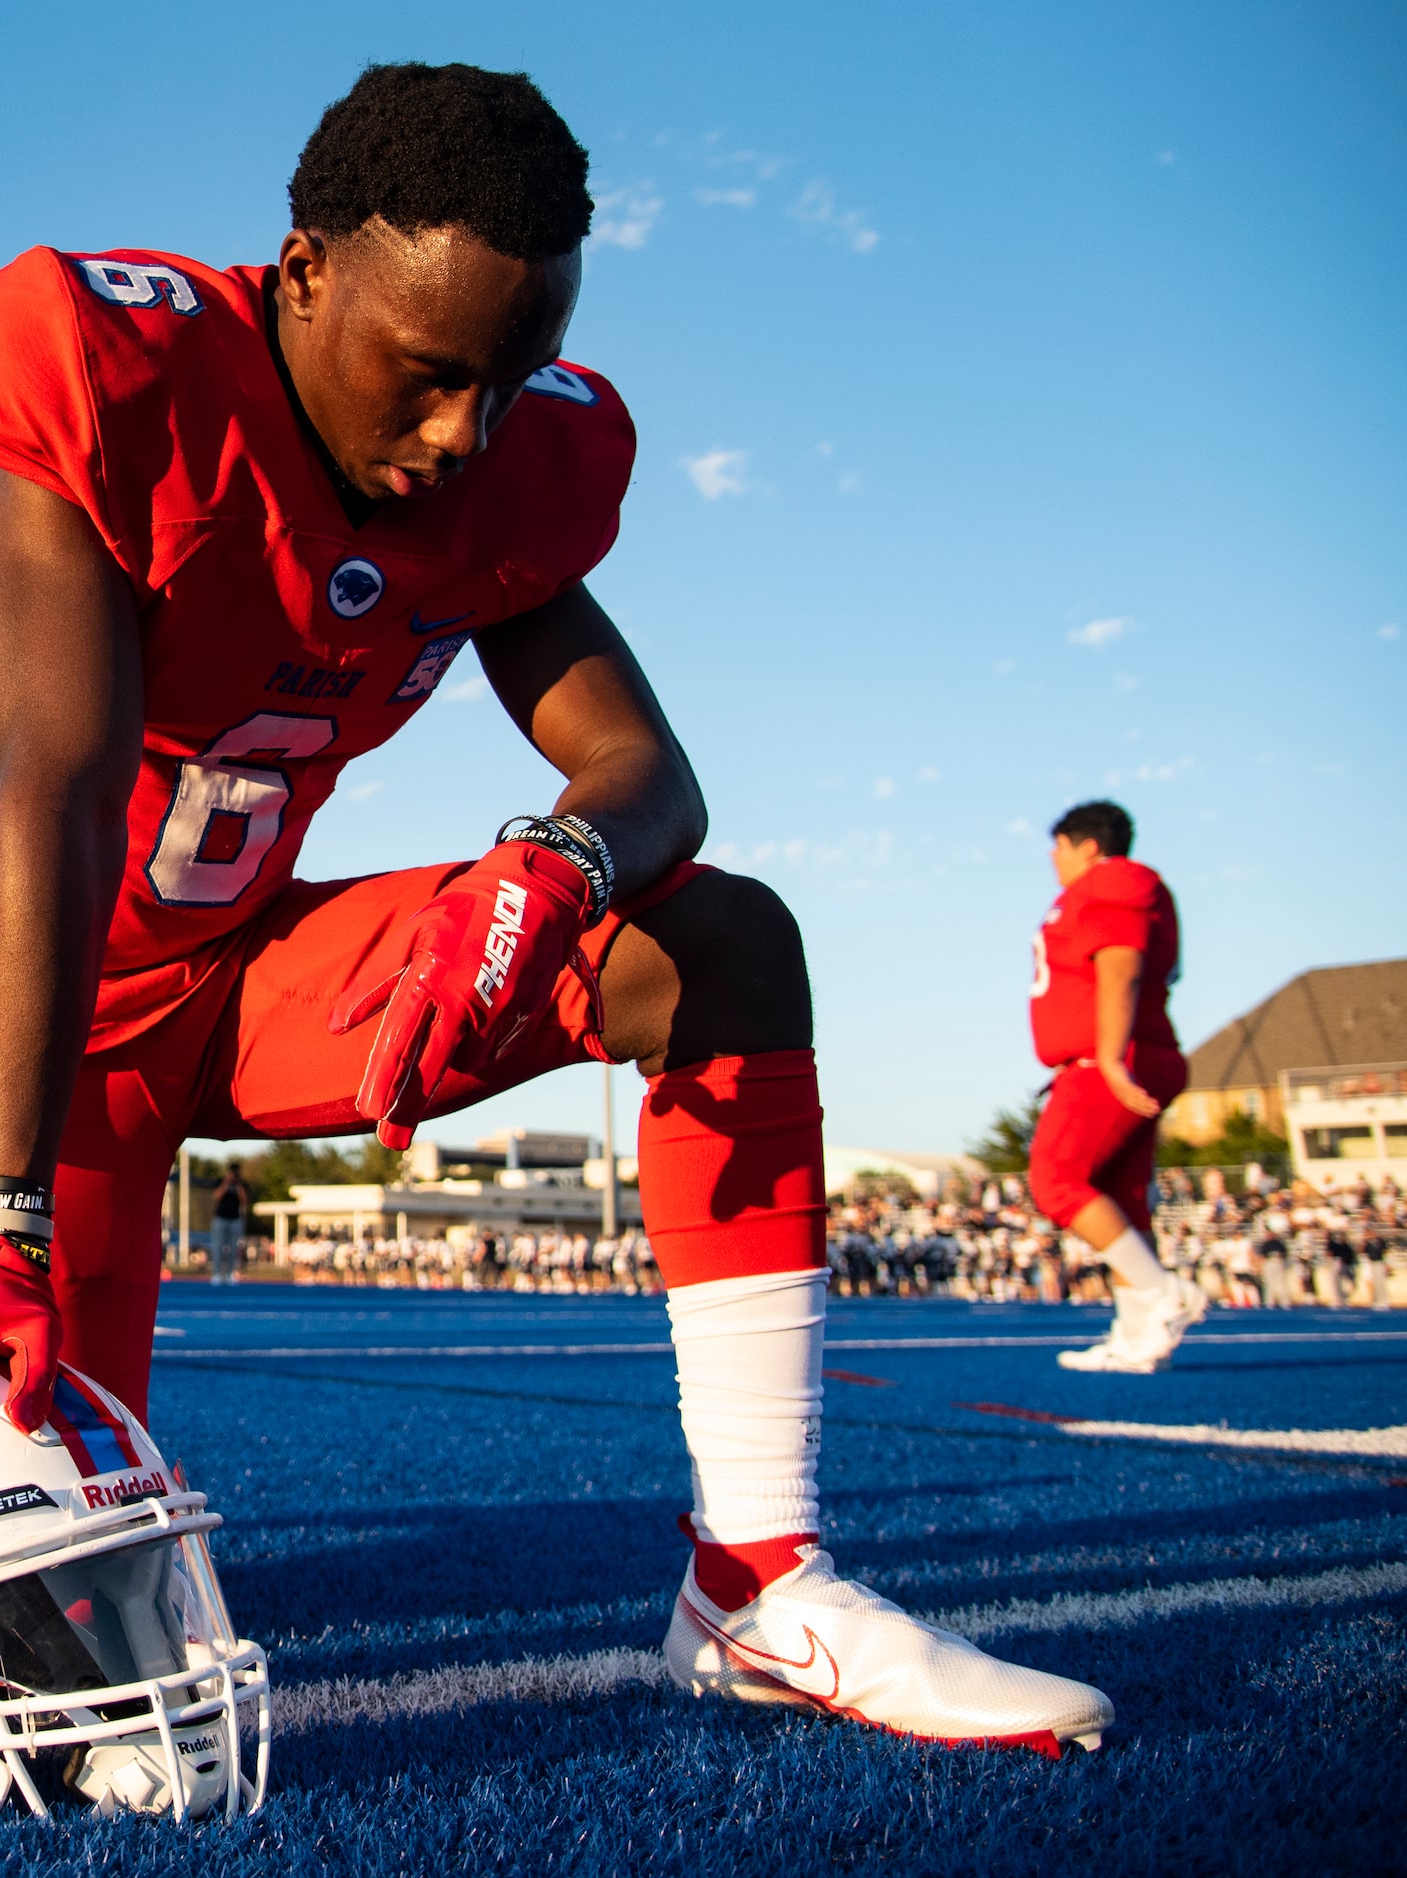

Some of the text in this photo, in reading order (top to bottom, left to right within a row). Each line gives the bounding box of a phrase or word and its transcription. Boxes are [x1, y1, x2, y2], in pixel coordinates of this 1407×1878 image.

[73, 259, 205, 317] 6
[264, 661, 367, 698] PARISH
[143, 709, 339, 908] 6
[563, 815, 615, 884] PHILIPPIANS
[474, 879, 528, 1008] PHENOM
[14, 1193, 44, 1210] GAIN.
[81, 1472, 168, 1509] Riddell
[177, 1734, 221, 1755] Riddell
